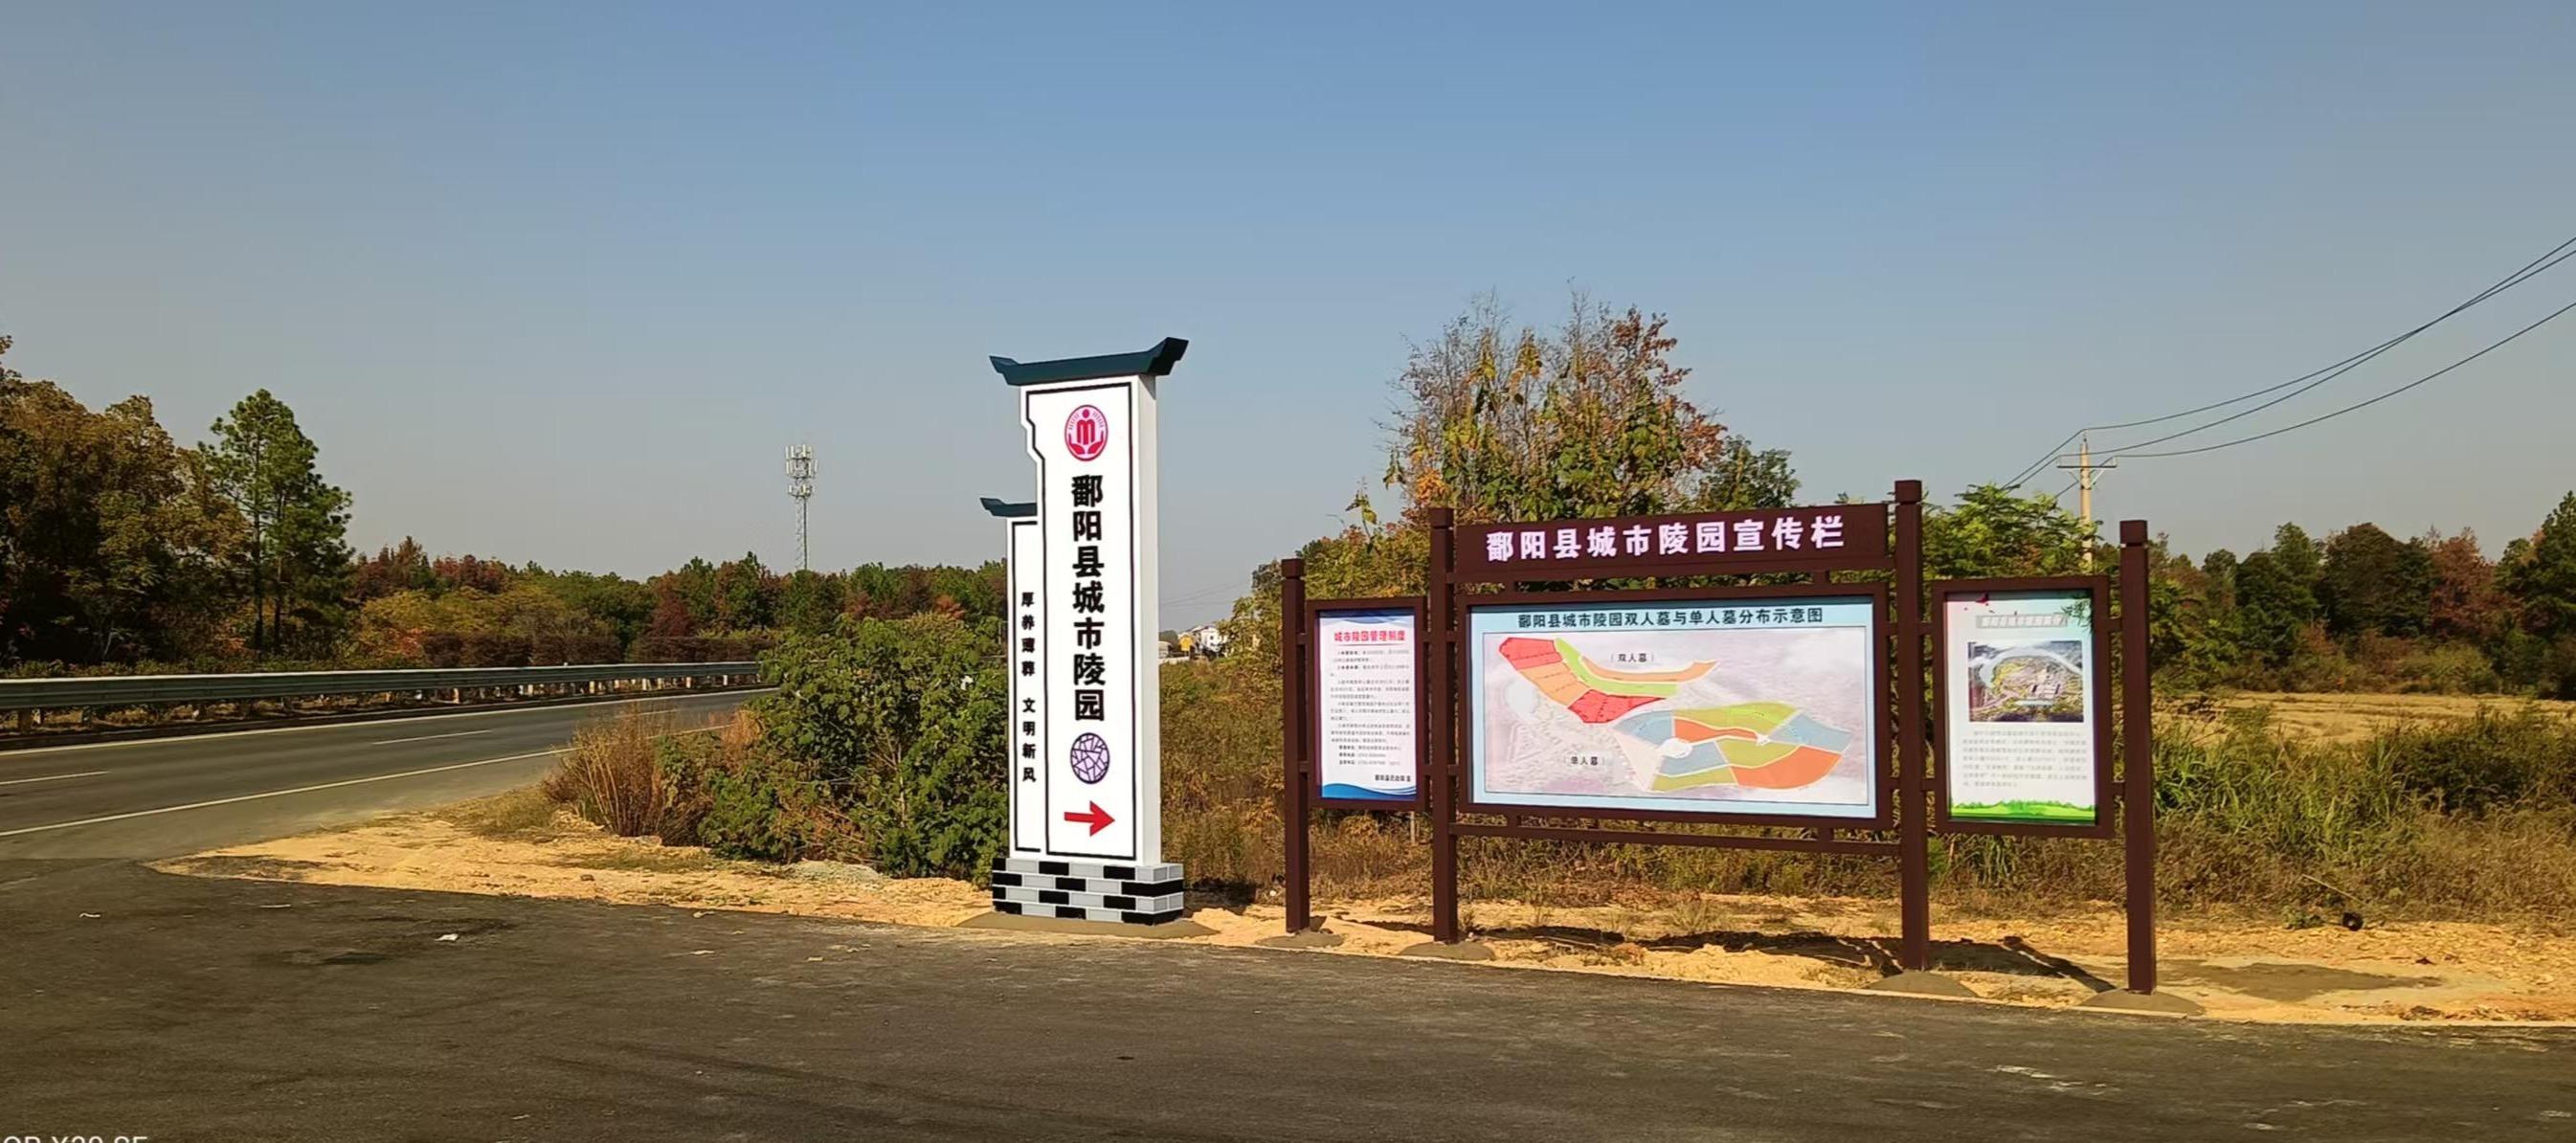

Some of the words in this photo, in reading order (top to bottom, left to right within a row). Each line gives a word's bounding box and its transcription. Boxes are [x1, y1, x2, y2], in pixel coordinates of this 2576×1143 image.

[1486, 514, 1845, 562] 鄱阳县城市陵园宣传栏
[1071, 475, 1106, 722] 鄱阳县城市陵园
[1518, 607, 1823, 628] 鄱阳县城市陵园双人墓与单人墓分布示意图
[1022, 698, 1037, 783] 文明新风
